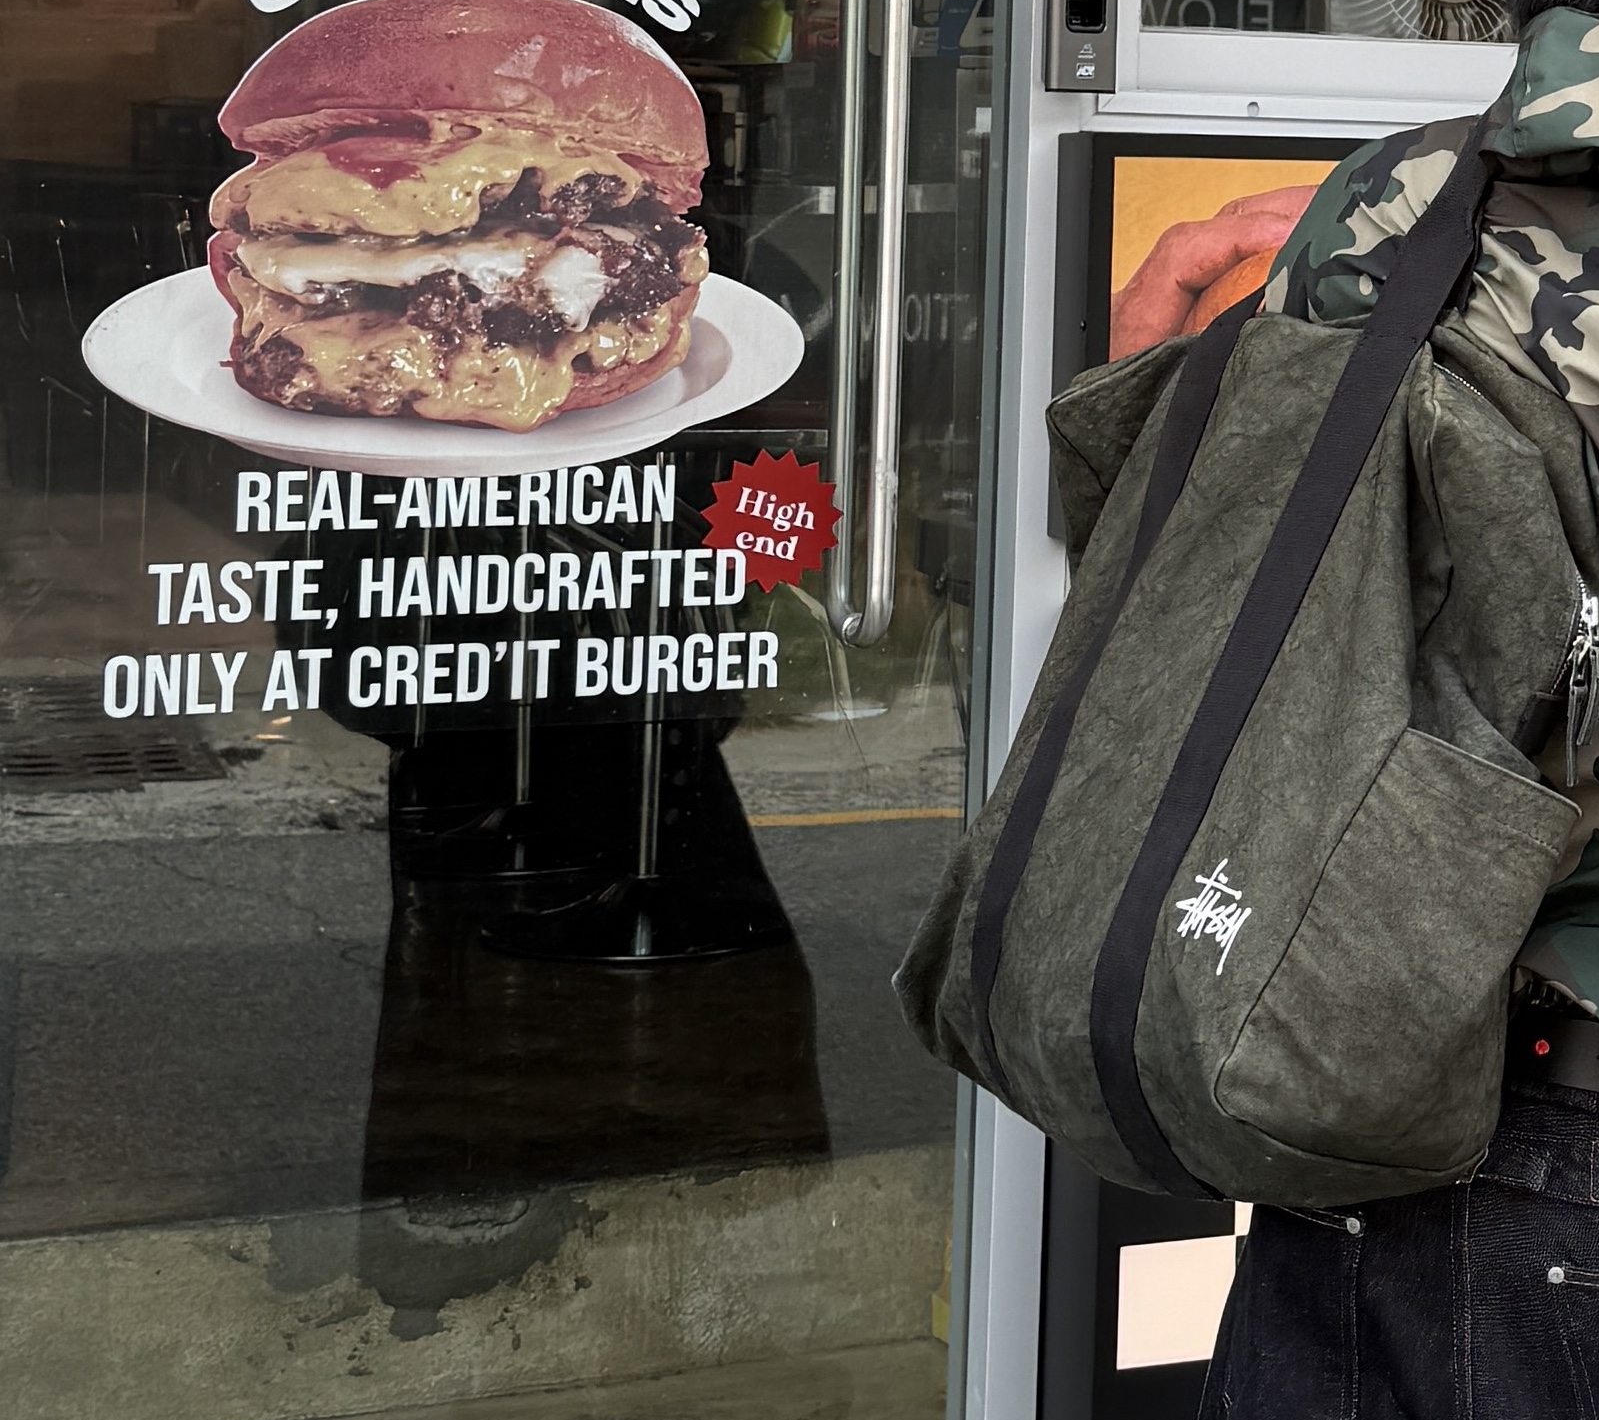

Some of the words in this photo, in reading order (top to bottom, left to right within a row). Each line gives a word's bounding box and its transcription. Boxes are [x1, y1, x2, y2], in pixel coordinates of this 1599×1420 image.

[234, 464, 677, 534] REAL-AMERICAN
[734, 485, 816, 536] High
[734, 525, 800, 563] end
[147, 561, 340, 631] TASTE,
[356, 547, 748, 622] HANDCRAFTED
[102, 651, 252, 719] ONLY
[261, 646, 334, 711] AT
[346, 637, 561, 710] CRED'IT
[572, 631, 780, 698] BURGER
